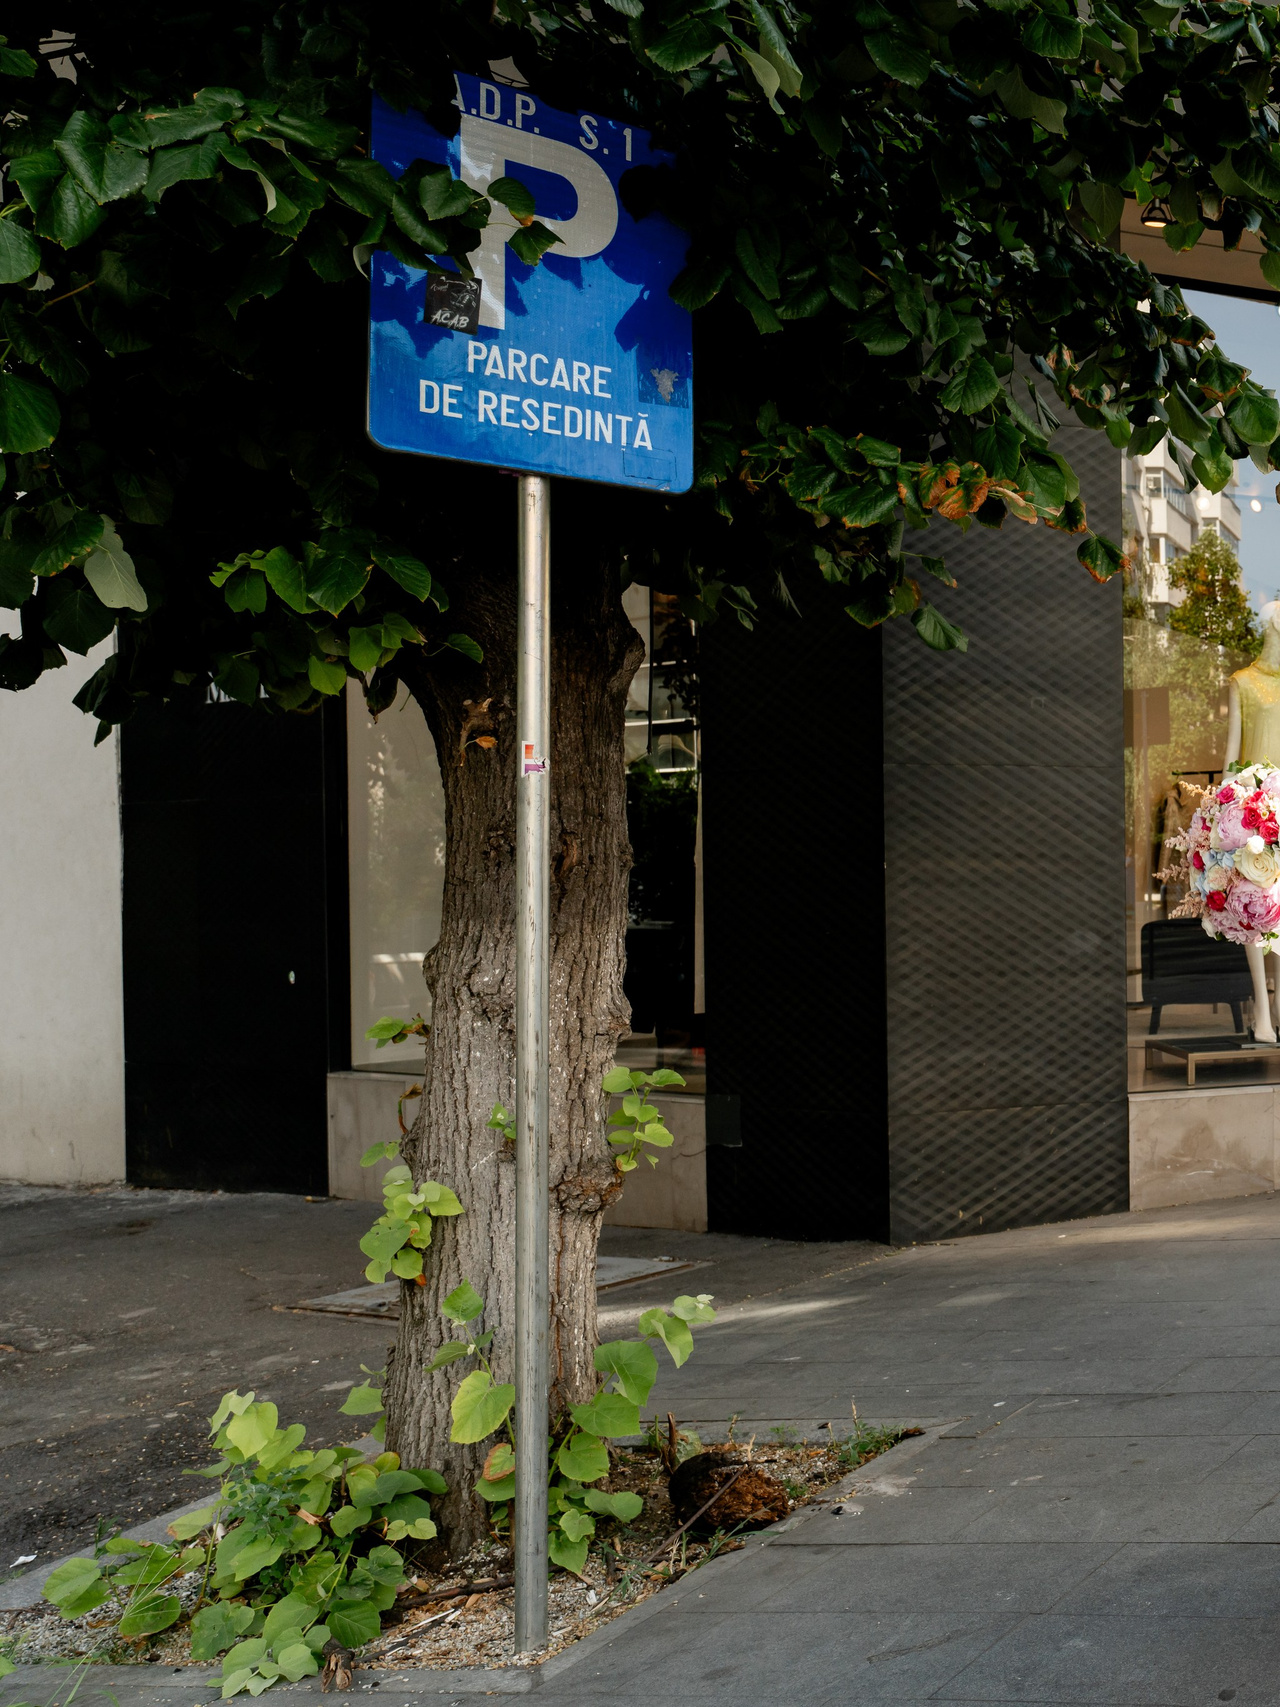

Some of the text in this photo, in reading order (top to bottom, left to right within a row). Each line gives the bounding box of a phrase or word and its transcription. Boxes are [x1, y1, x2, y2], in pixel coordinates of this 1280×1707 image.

[461, 112, 619, 330] P
[467, 340, 612, 399] PARCARE
[419, 379, 653, 451] DE REȘEDINȚĂ
